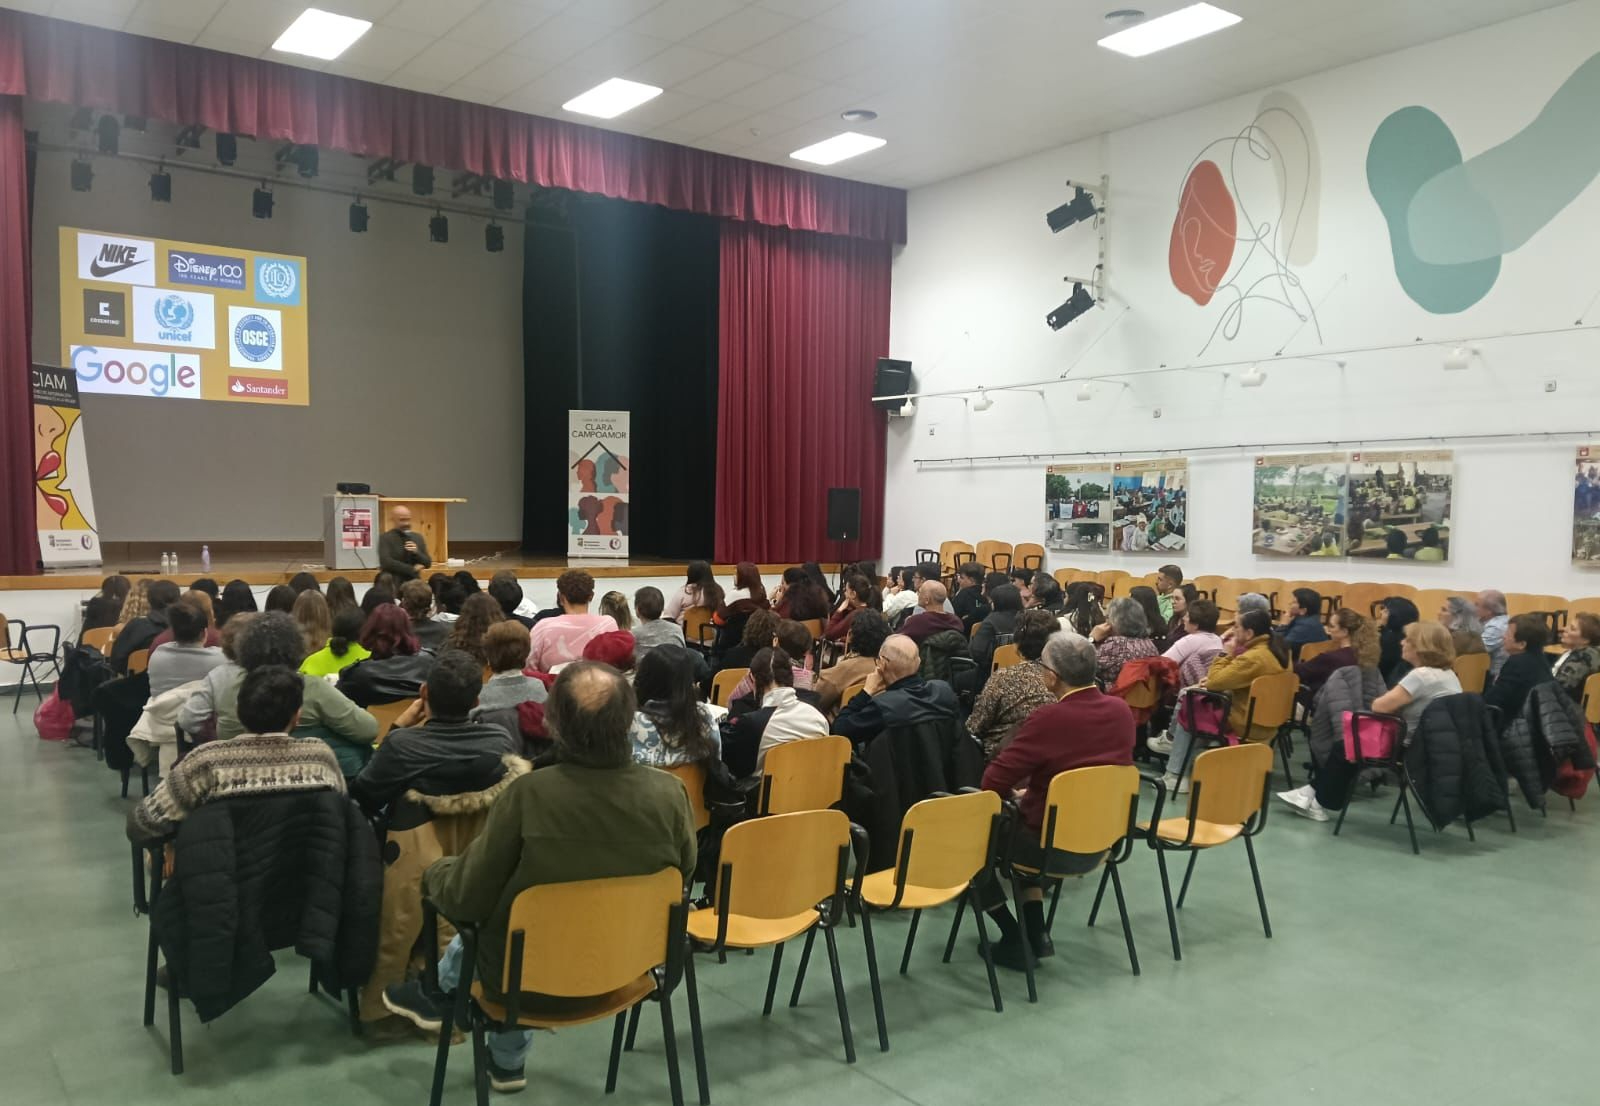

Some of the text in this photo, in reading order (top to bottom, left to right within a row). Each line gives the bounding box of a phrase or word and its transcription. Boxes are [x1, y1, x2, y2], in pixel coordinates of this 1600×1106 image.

[99, 243, 137, 264] NIKE
[158, 329, 192, 342] unicef
[242, 329, 269, 347] OSCE
[72, 346, 195, 396] Google
[246, 383, 286, 395] Santander
[585, 423, 613, 431] CLARA
[571, 430, 627, 439] CAMPOAMOR
